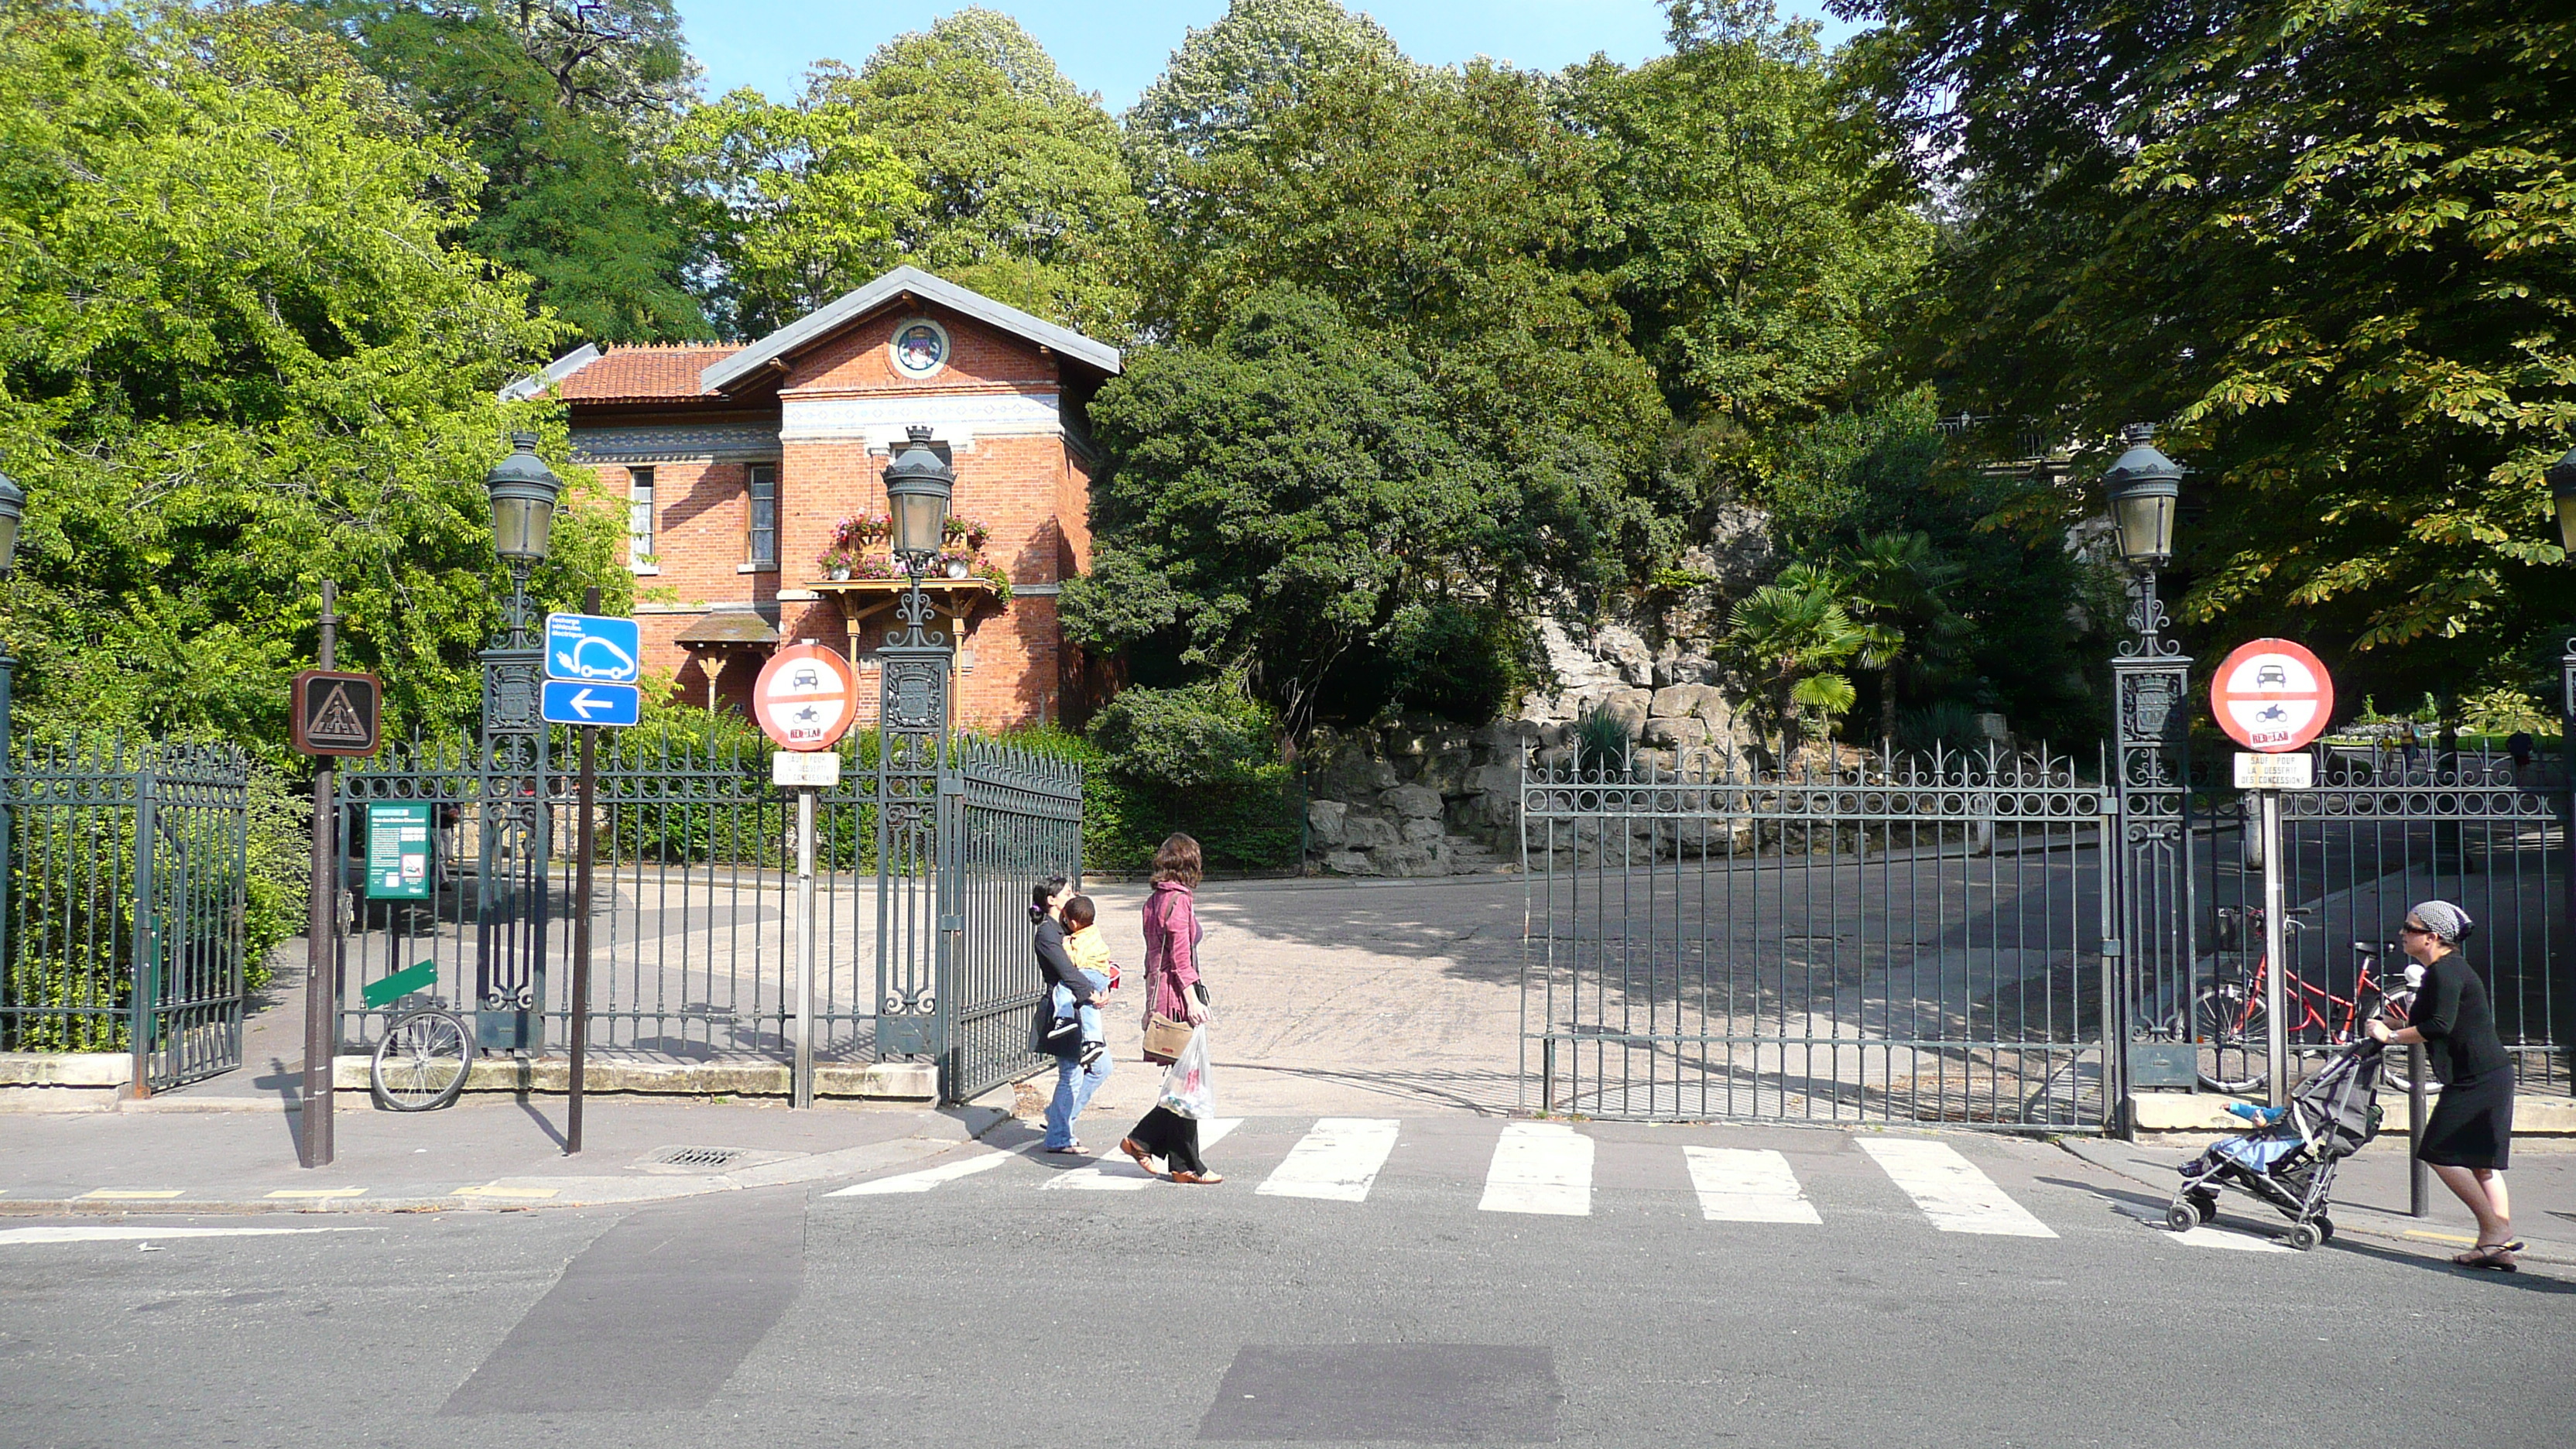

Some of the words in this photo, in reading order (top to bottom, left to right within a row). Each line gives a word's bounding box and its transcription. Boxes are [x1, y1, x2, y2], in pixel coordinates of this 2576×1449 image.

[2250, 756, 2269, 765] SAUF
[2276, 756, 2296, 765] POUR
[2241, 776, 2254, 784] DES
[2258, 776, 2305, 784] CONCESSIONS
